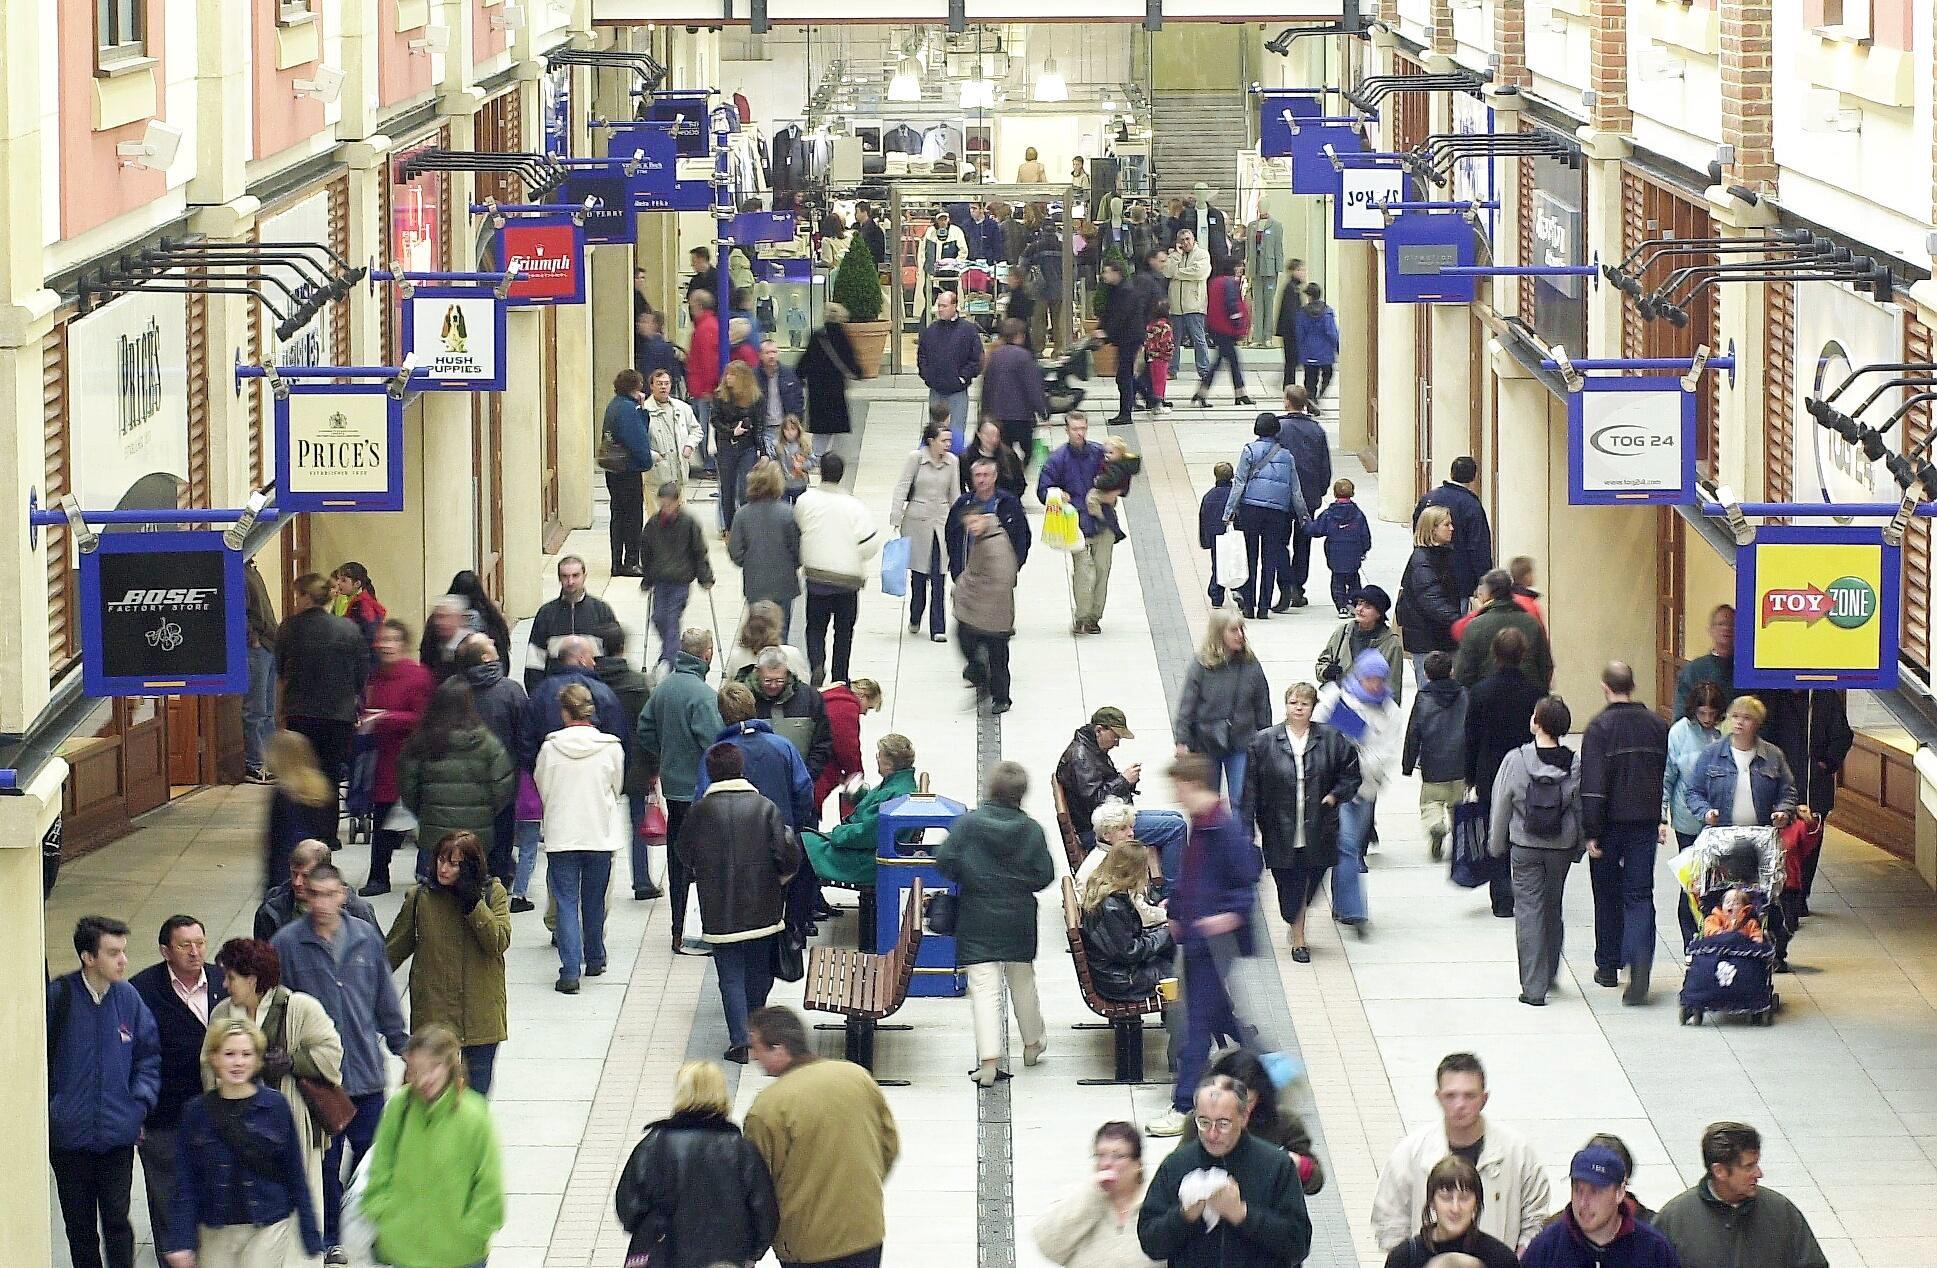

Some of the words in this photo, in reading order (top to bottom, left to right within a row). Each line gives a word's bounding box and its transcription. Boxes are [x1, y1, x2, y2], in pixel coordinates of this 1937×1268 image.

[435, 356, 474, 365] HUSH
[426, 365, 483, 374] PUPPIES
[1610, 436, 1645, 447] TOG
[1650, 436, 1675, 447] 24
[298, 439, 380, 469] PRICE'S
[108, 588, 218, 606] BOSE
[1769, 594, 1824, 613] TOY
[1828, 588, 1870, 617] ZONE
[108, 604, 164, 613] FACTORY
[172, 604, 210, 612] STORE
